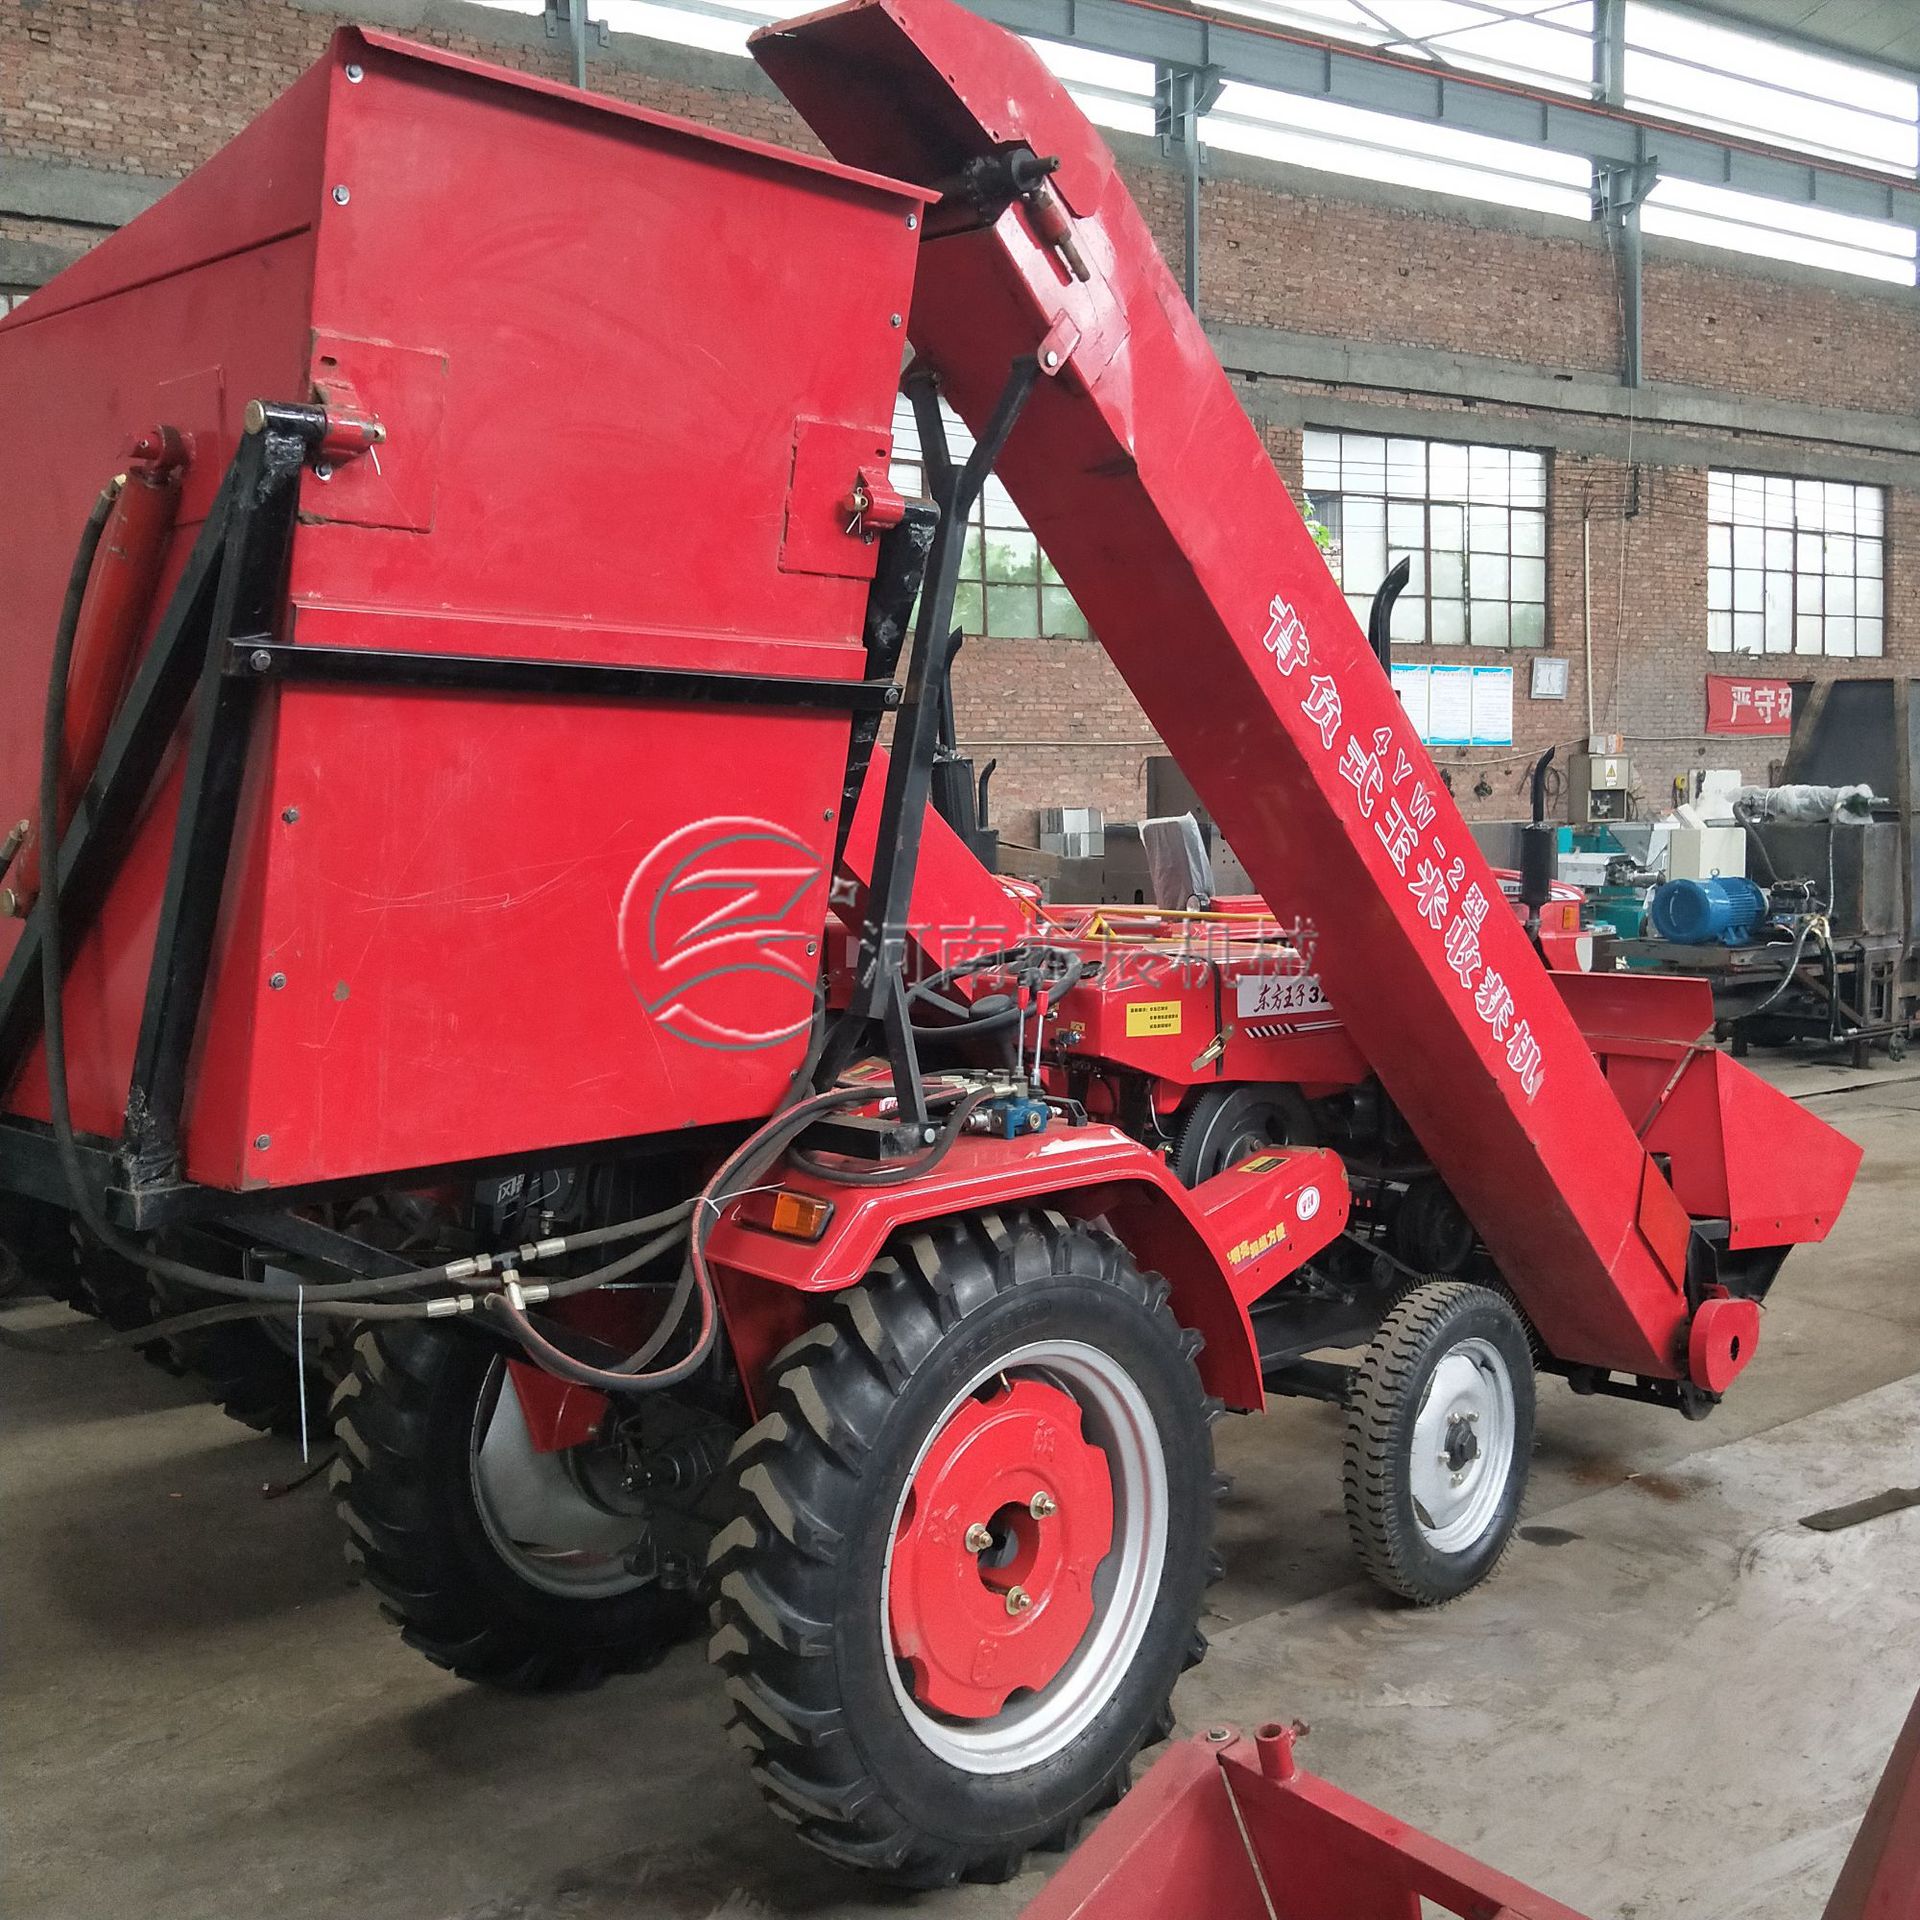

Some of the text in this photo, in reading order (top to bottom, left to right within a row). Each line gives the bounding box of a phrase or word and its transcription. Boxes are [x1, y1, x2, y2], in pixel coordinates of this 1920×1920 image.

[1262, 593, 1542, 1094] 背负式玉米收获机
[1372, 726, 1490, 933] 4YW-2型
